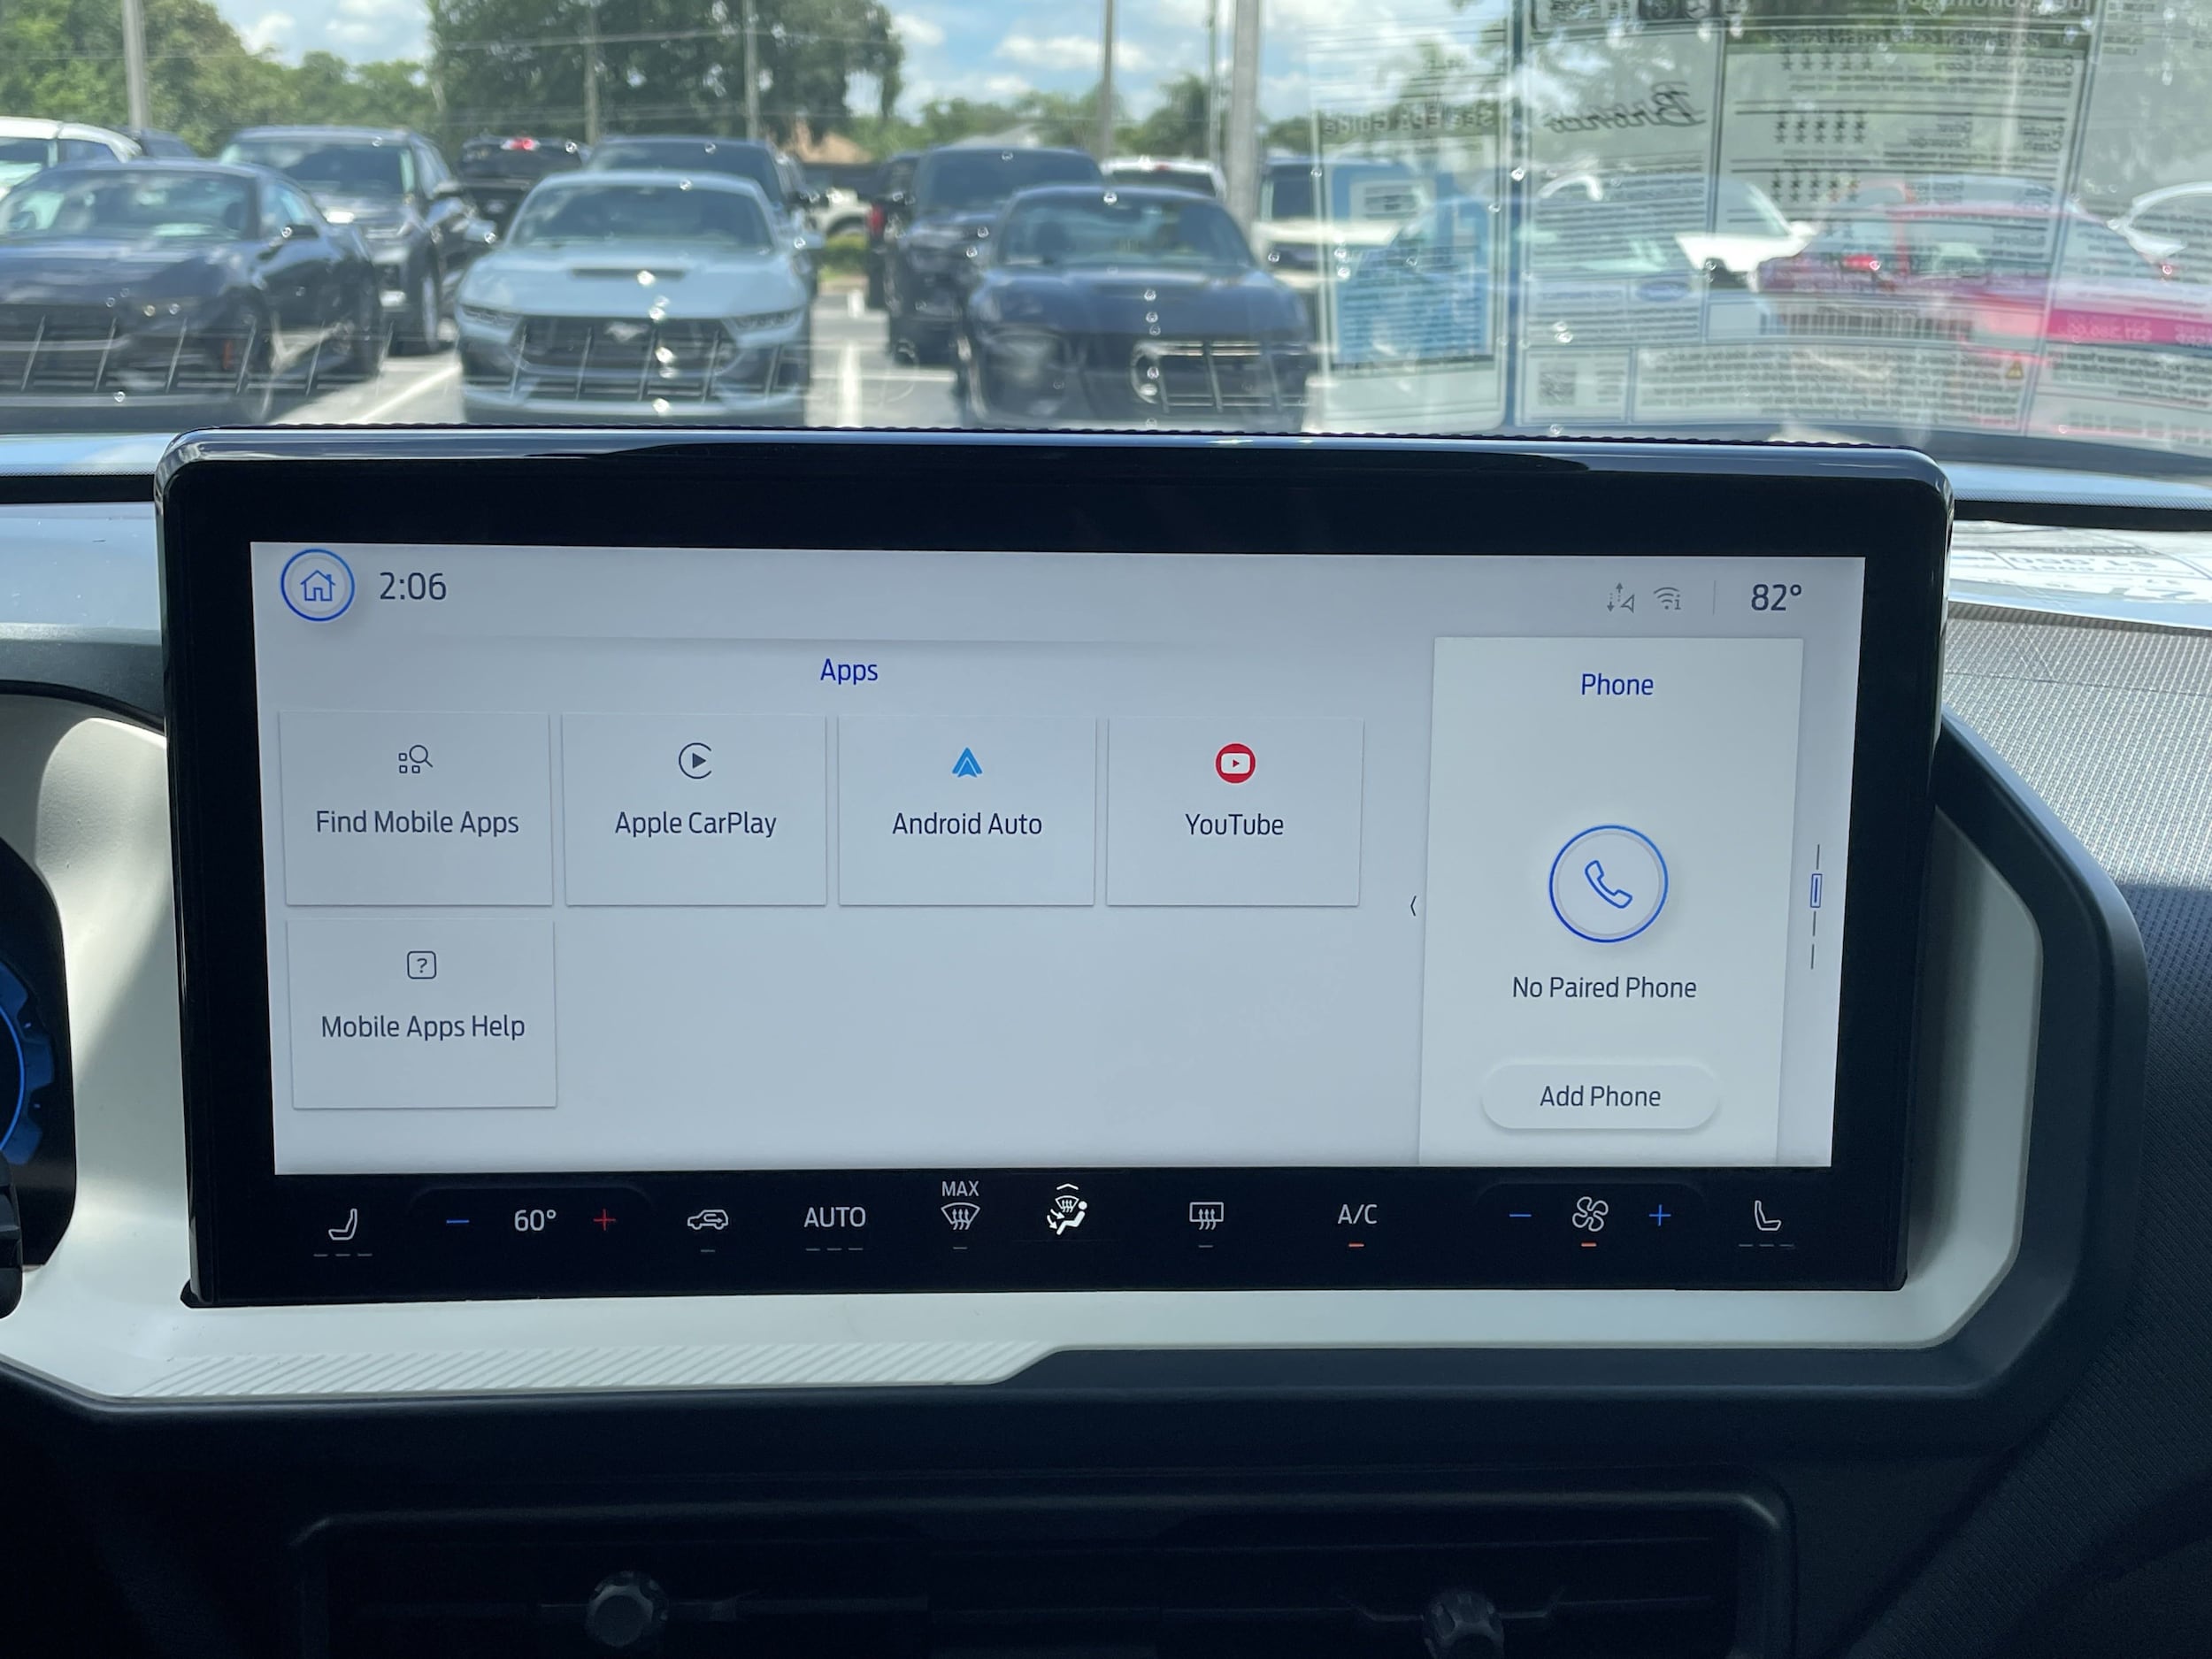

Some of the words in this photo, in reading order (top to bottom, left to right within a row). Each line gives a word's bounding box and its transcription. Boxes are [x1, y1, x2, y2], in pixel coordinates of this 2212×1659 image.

[380, 572, 447, 601] 2:06
[1751, 583, 1802, 611] 82°
[820, 657, 879, 686] Apps
[1581, 672, 1654, 695] Phone
[317, 810, 367, 833] Find
[374, 810, 453, 833] Mobile
[459, 810, 519, 838] Apps
[615, 810, 682, 838] Apple
[688, 810, 777, 838] CarPlay
[892, 811, 981, 834] Android
[987, 812, 1042, 835] Auto
[1185, 812, 1284, 835] YouTube
[1513, 976, 1543, 998] No
[1549, 976, 1619, 998] Paired
[1626, 976, 1697, 998] Phone
[322, 1015, 400, 1038] Mobile
[406, 1015, 465, 1041] Apps
[472, 1014, 525, 1041] Help
[1540, 1085, 1584, 1107] Add
[1590, 1085, 1661, 1107] Phone
[941, 1180, 979, 1197] MAX
[514, 1209, 557, 1232] 60°
[803, 1206, 866, 1228] AUTO
[1337, 1203, 1378, 1225] A/C
